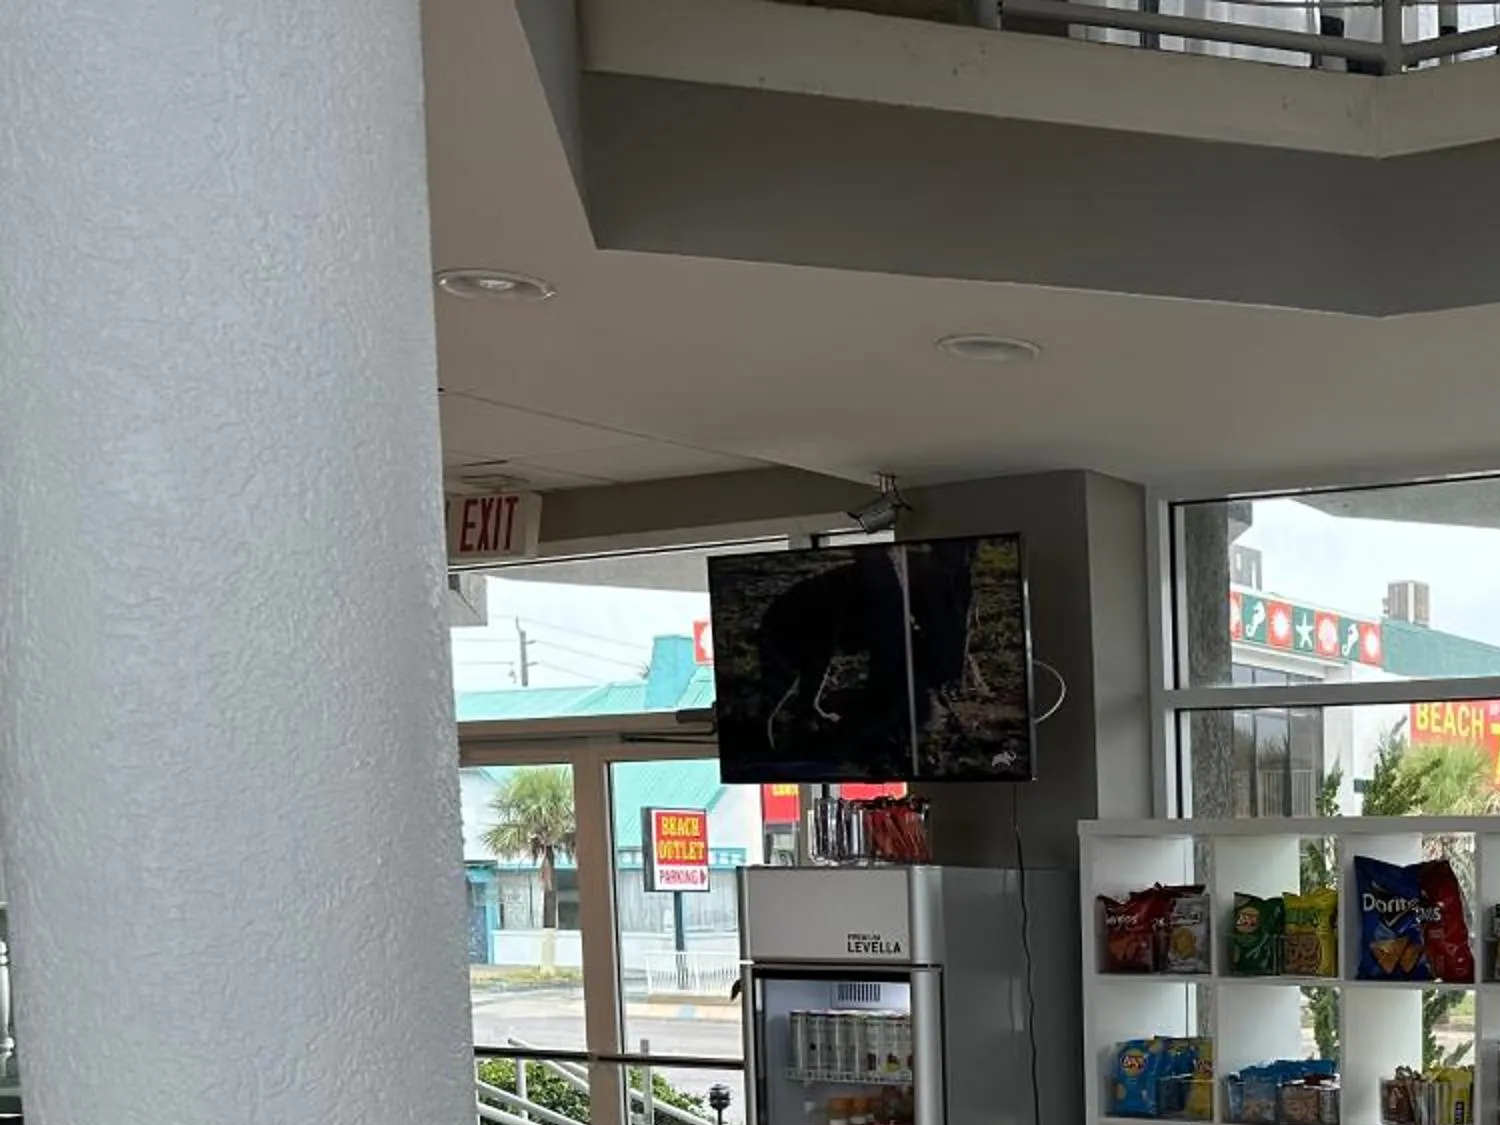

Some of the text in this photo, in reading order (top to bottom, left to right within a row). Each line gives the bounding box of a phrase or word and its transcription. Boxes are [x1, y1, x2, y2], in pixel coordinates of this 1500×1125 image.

[460, 496, 518, 551] EXIT
[1415, 702, 1484, 741] BEACH
[661, 815, 700, 837] BEACH
[659, 840, 705, 861] OUTLET
[659, 869, 699, 884] PARKING
[847, 941, 901, 954] LEVELLA
